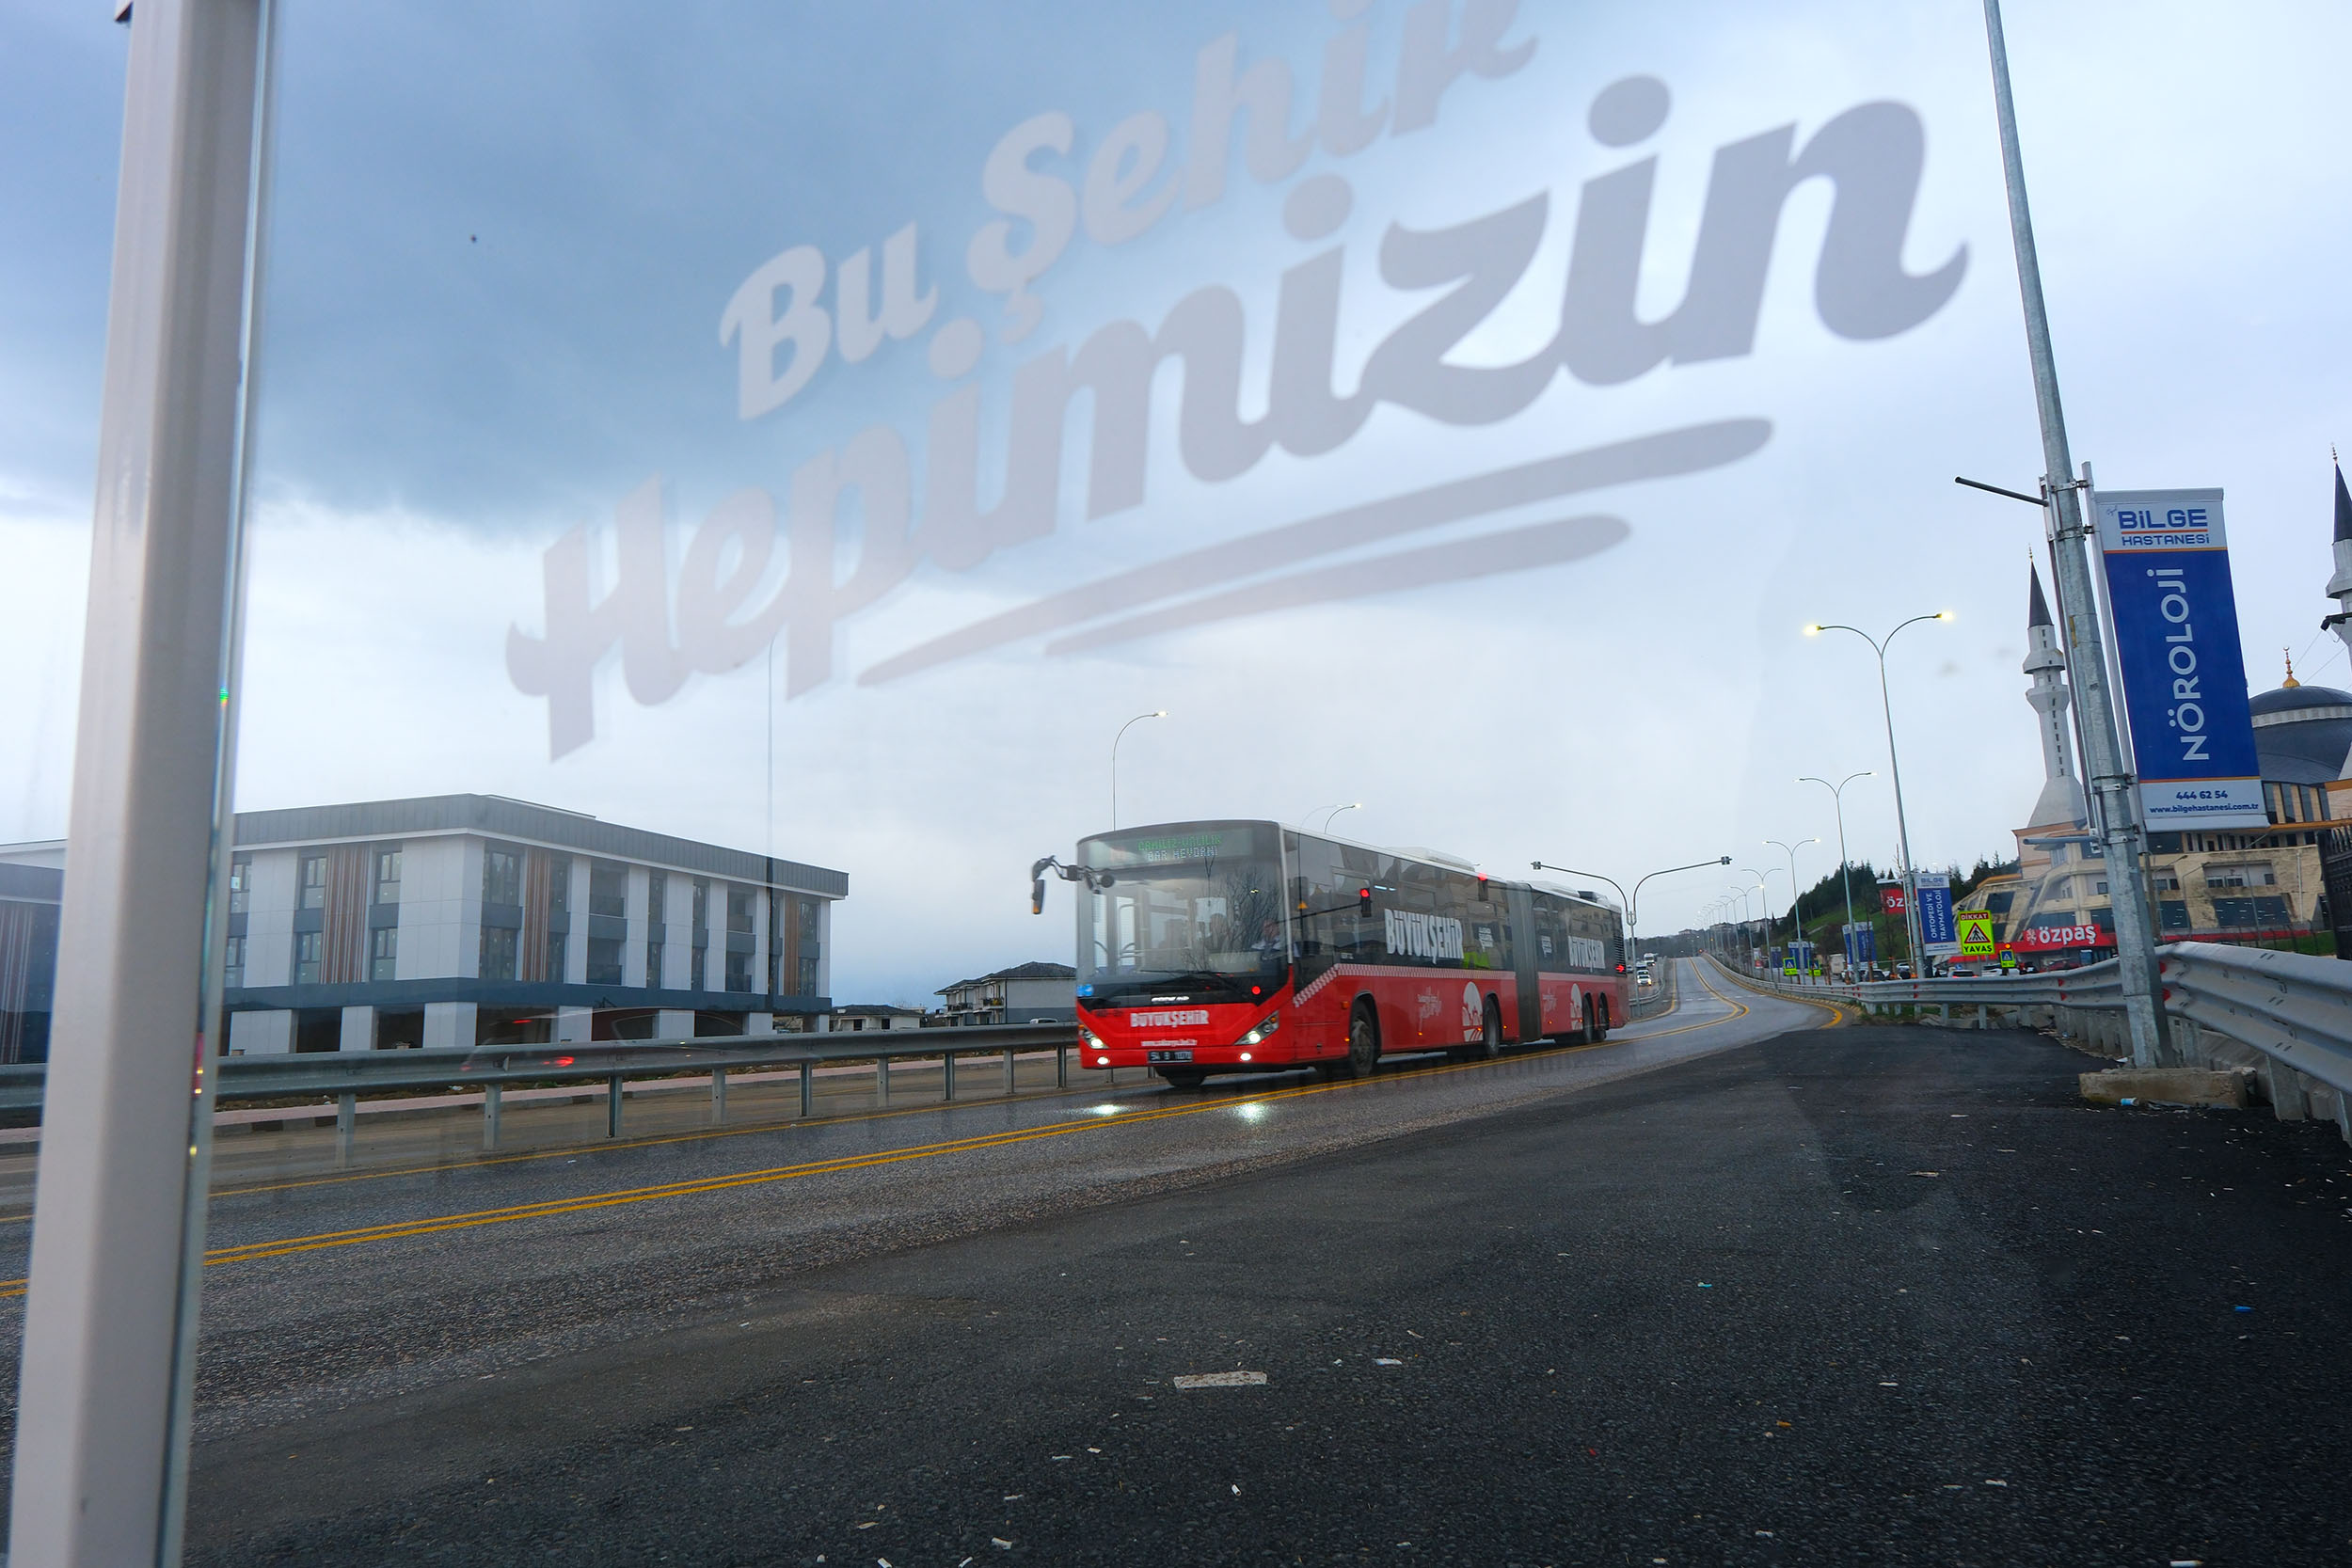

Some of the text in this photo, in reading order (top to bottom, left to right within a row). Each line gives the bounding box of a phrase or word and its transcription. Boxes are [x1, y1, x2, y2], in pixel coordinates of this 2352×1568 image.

[719, 222, 939, 421] Bu
[506, 73, 1969, 762] Hepimizin
[2146, 568, 2210, 761] NÖROLOJİ
[2175, 789, 2229, 800] 444 62 54
[2149, 802, 2259, 814] www.bilgehastanesi.com.tr
[1961, 912, 1988, 921] DİKKAT
[1384, 908, 1465, 965] BÜYÜKŞEHİR
[2039, 926, 2097, 944] özpaş
[1130, 1010, 1209, 1027] BÜYÜKŞEHİR
